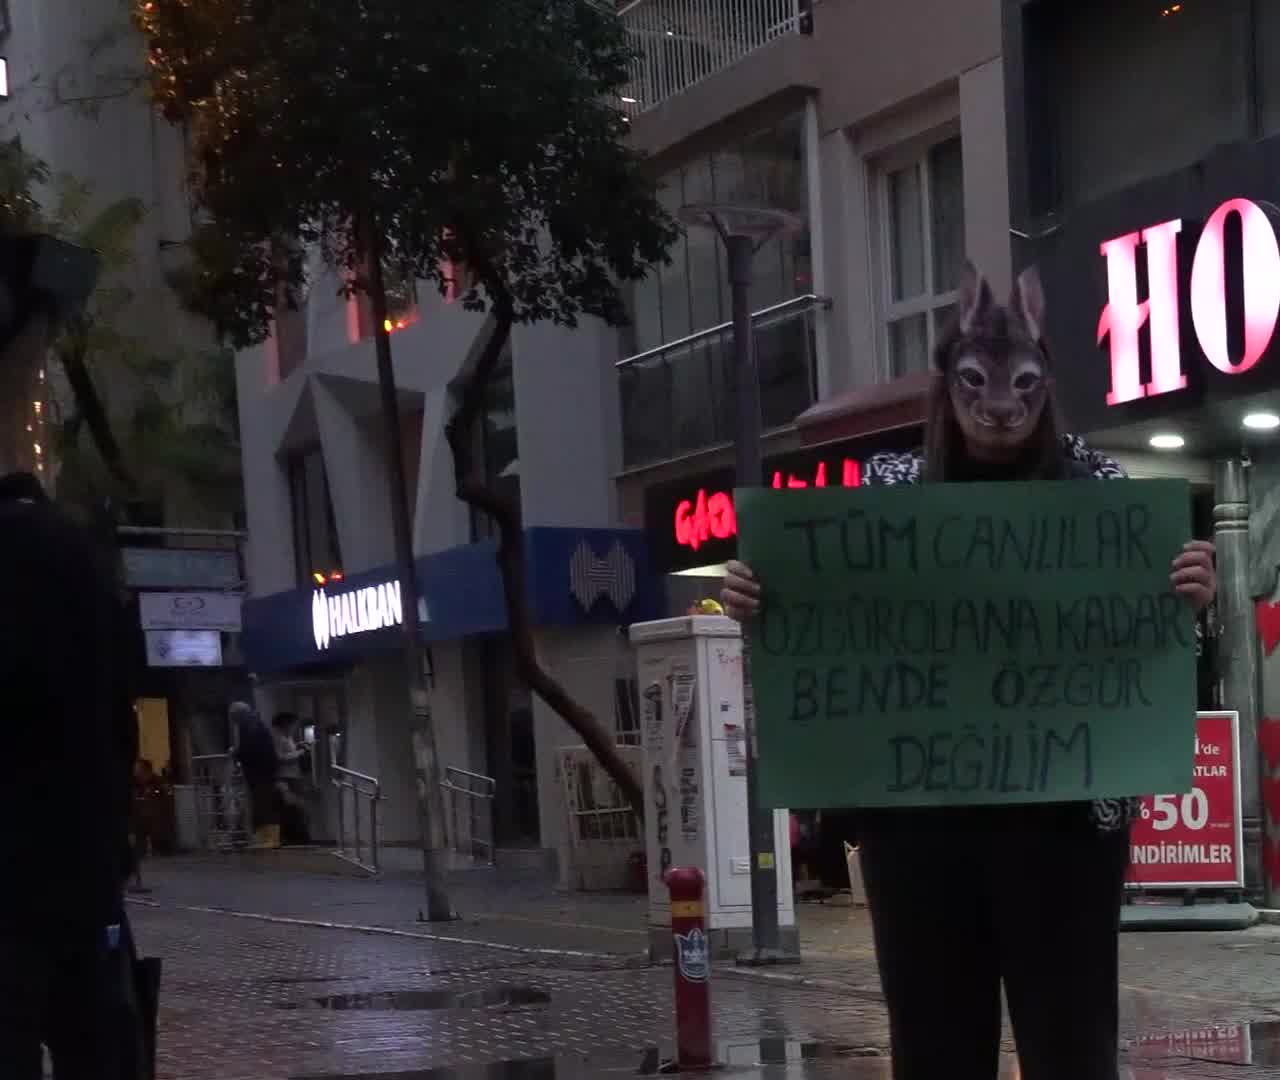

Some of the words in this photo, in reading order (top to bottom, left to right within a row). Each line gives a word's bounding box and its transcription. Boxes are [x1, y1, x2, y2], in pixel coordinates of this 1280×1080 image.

[784, 509, 919, 575] TÜM
[932, 503, 1153, 572] CANLILAR
[328, 579, 431, 638] HALKBAN
[1056, 591, 1194, 651] KADAR
[789, 663, 949, 723] BENDE
[993, 657, 1152, 710] ÖZGÜR
[886, 721, 1094, 795] DEĞİLİM
